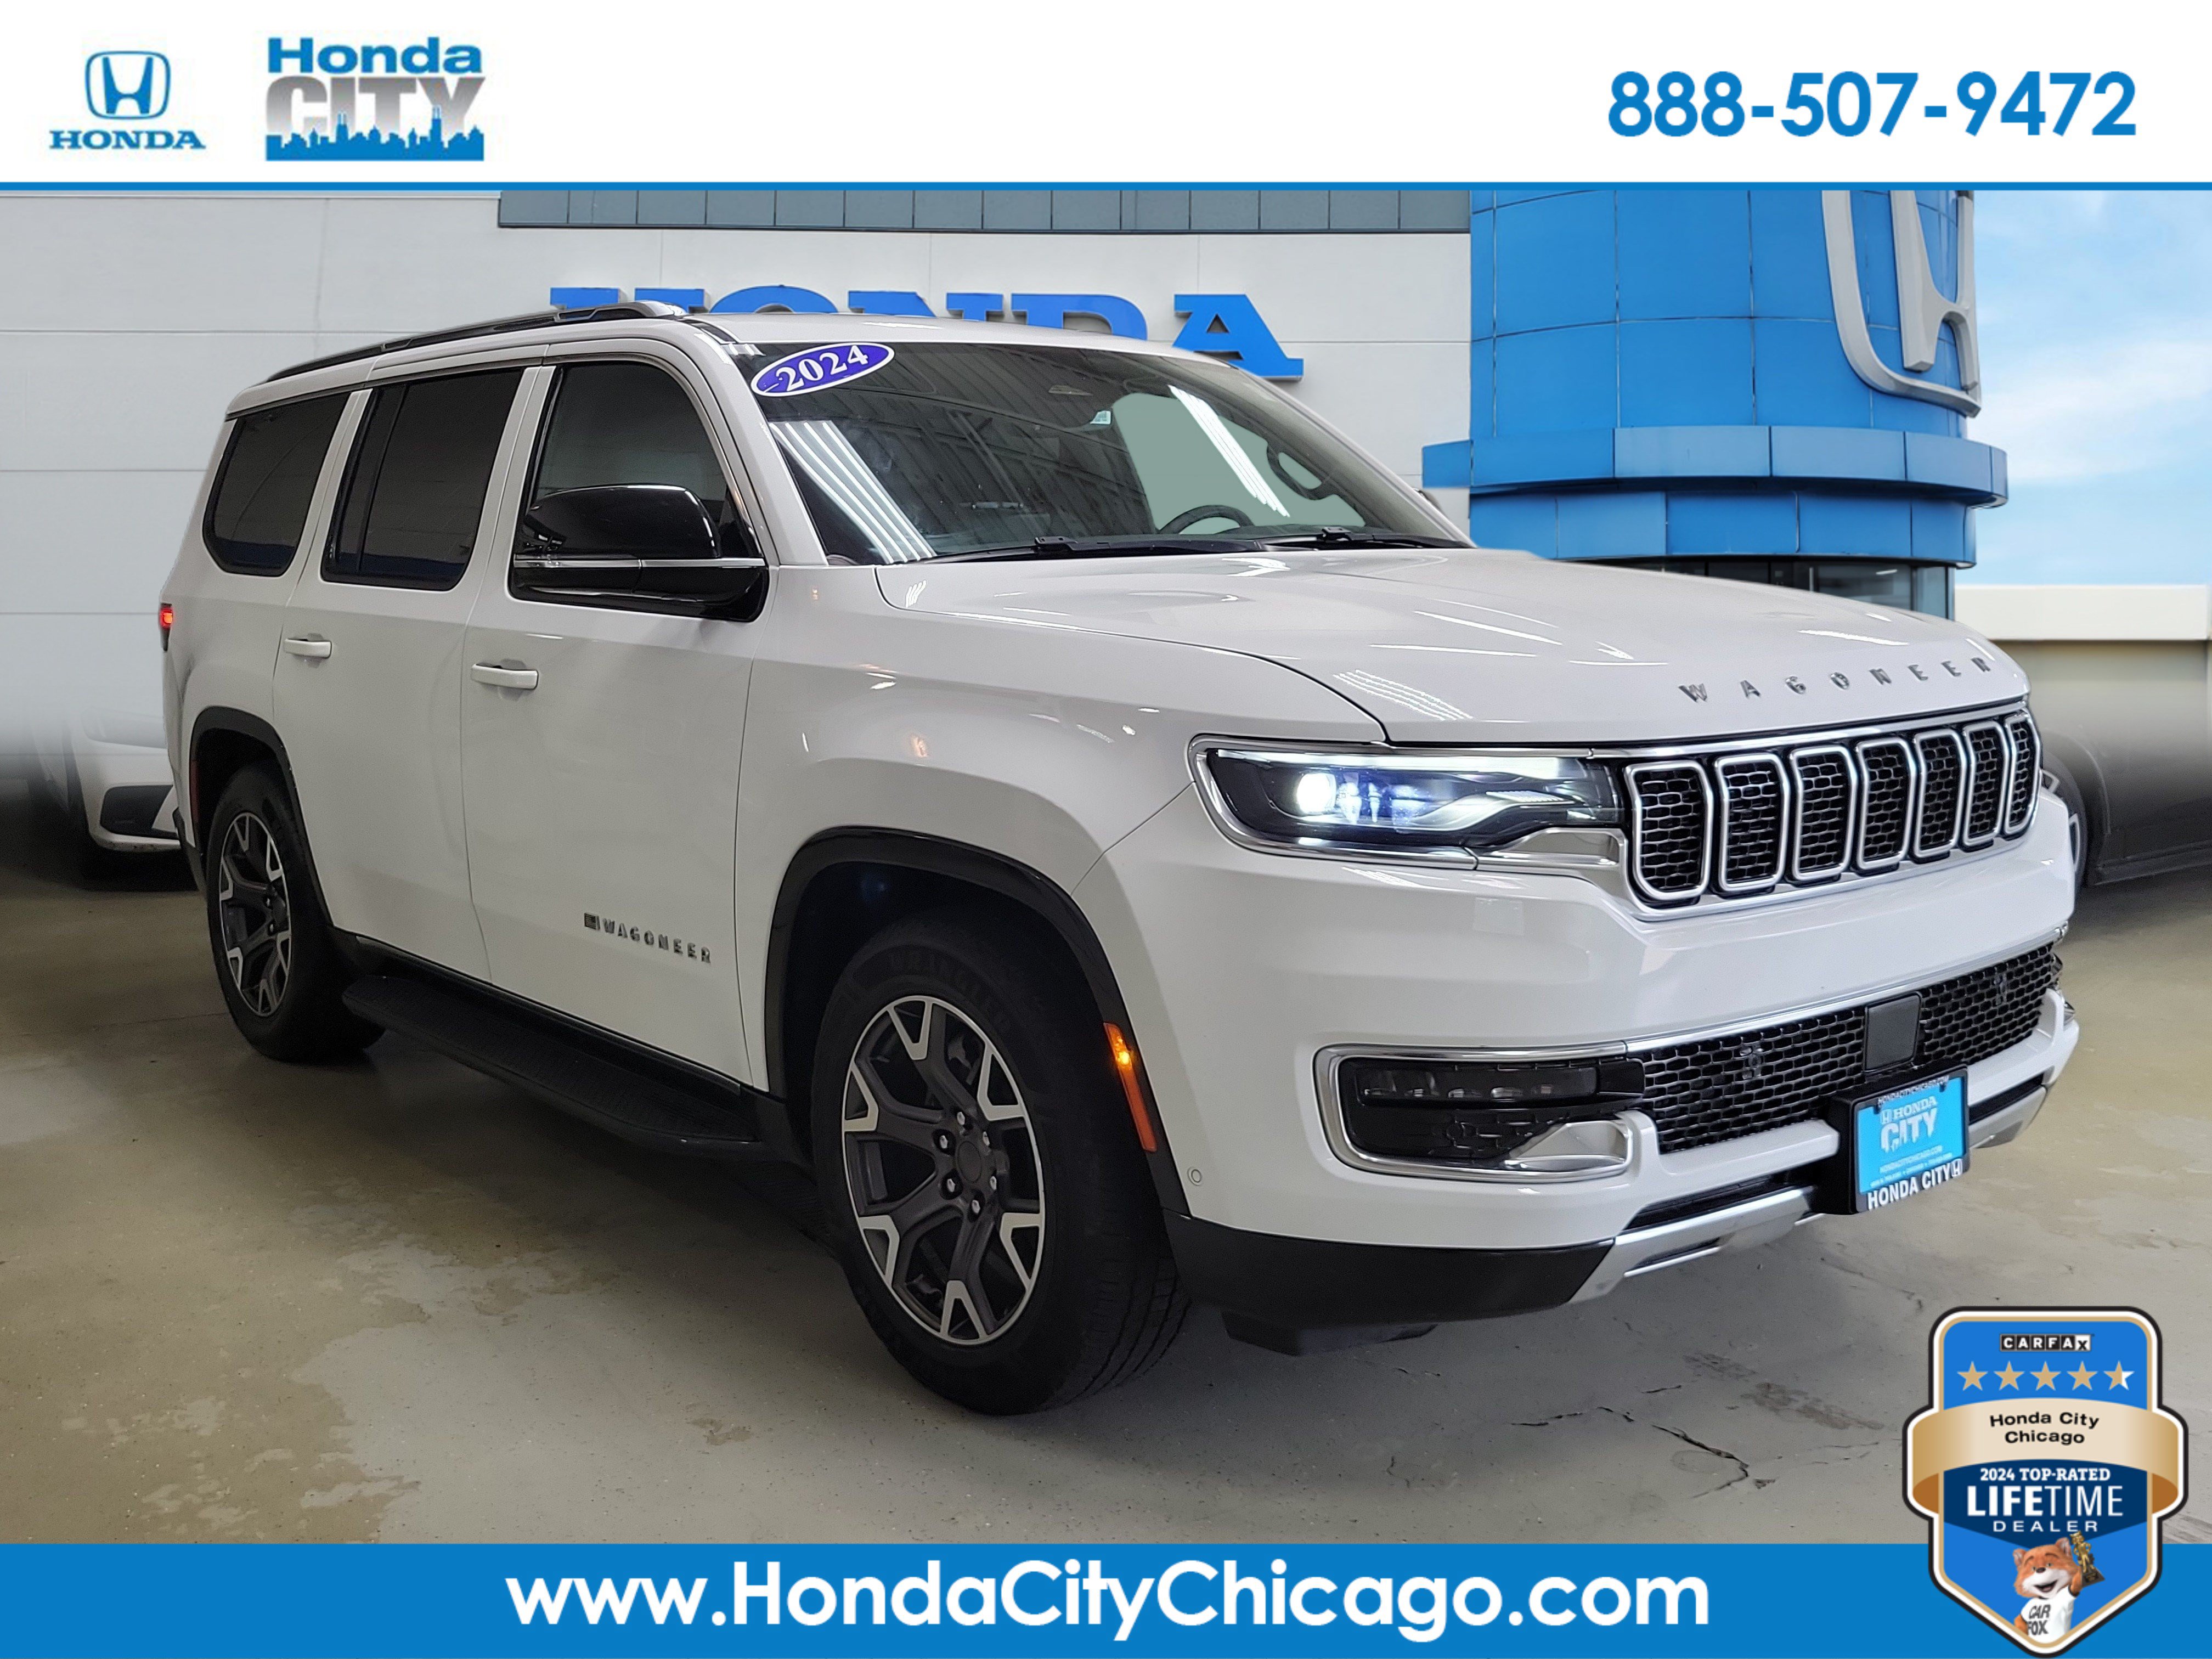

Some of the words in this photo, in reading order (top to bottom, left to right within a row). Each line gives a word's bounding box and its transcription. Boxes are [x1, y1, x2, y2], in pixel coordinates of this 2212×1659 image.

[776, 345, 868, 391] 2024
[1678, 657, 1991, 703] WAGONEER
[602, 917, 712, 964] WAGONEER
[1880, 1107, 1938, 1153] CITY
[1893, 1096, 1938, 1120] HONDA
[1867, 1176, 1919, 1211] HONDA
[1921, 1162, 1951, 1190] CITY
